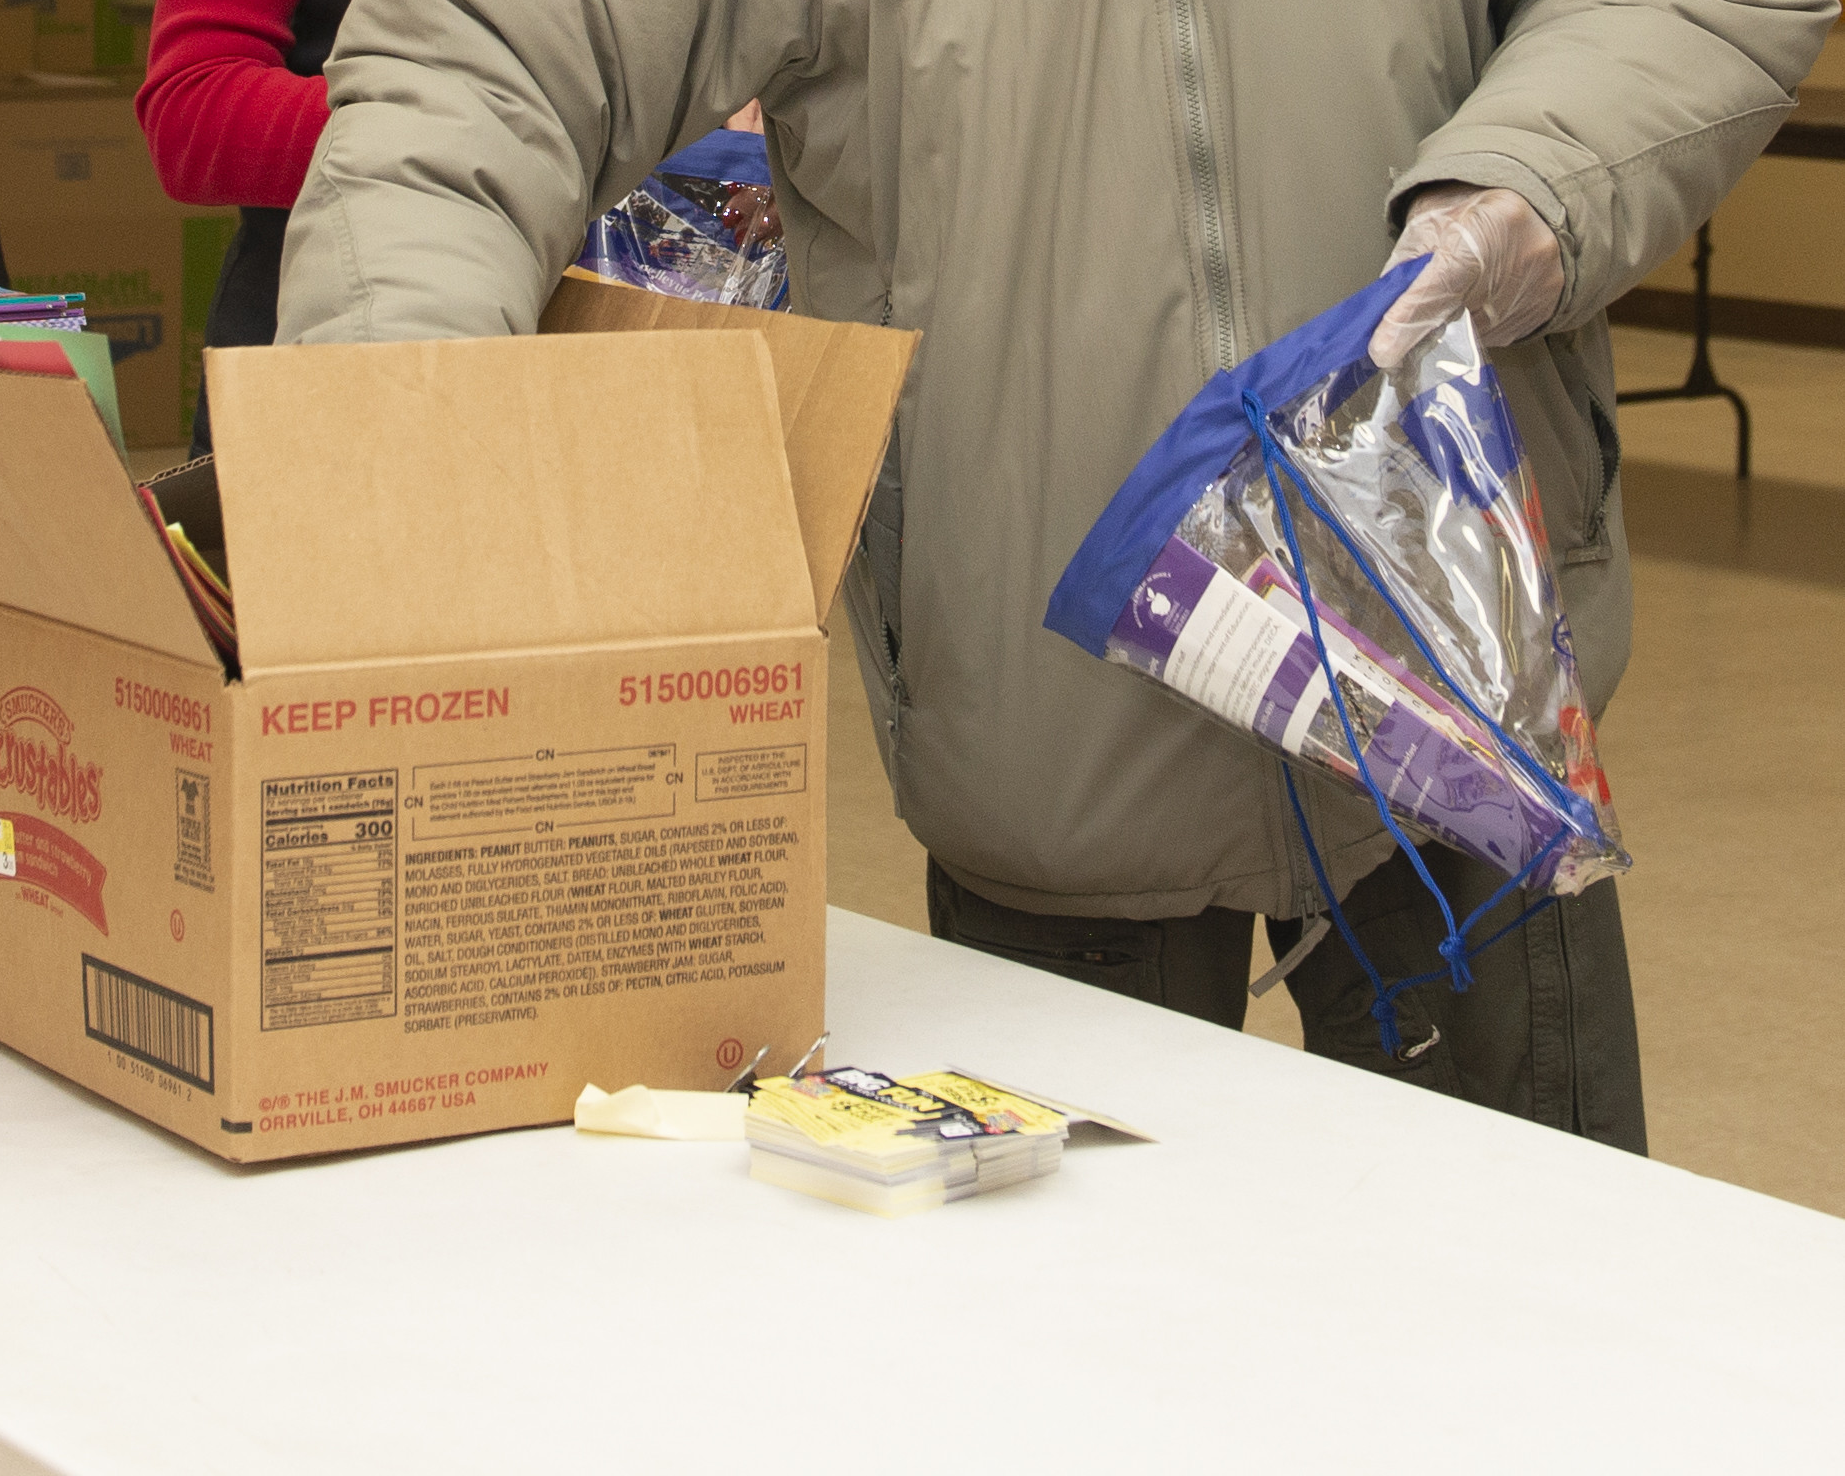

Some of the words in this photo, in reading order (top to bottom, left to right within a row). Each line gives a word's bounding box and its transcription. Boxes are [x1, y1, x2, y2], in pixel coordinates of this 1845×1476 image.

[619, 662, 802, 706] 5150006961
[115, 676, 211, 734] 5150006961
[261, 699, 357, 736] KEEP
[369, 687, 509, 727] FROZEN
[729, 698, 805, 724] WHEAT
[169, 732, 214, 763] WHEAT
[536, 749, 555, 761] CN
[266, 781, 342, 797] Nutrition
[347, 774, 394, 790] Facts
[665, 773, 684, 786] CN
[404, 796, 423, 809] CN
[265, 832, 329, 847] Calories
[354, 820, 392, 839] 300
[480, 843, 522, 858] PEANUT
[660, 824, 709, 840] CONTAINS
[711, 823, 727, 836] 2%
[730, 821, 744, 834] OR
[746, 818, 770, 832] LESS
[535, 821, 553, 833] CN
[405, 884, 438, 899] MONO
[440, 881, 463, 895] AND
[612, 859, 677, 878] UNBLEACHED
[680, 856, 715, 871] WHOLE
[718, 852, 751, 867] WHEAT
[468, 861, 499, 876] FULLY
[501, 853, 583, 873] HYDROGENATED
[586, 848, 641, 864] VEGETABLE
[644, 845, 666, 859] OILS
[669, 839, 724, 858] (RAPESEED
[725, 837, 747, 851] AND
[405, 898, 458, 915] ENRICHED
[461, 891, 528, 910] UNBLEACHED
[531, 887, 565, 902] FLOUR
[567, 883, 606, 900] (WHEAT
[646, 875, 686, 890] MALTED
[688, 871, 725, 886] BARLEY
[446, 911, 495, 928] FERROUS
[546, 902, 588, 917] THIAMIN
[730, 884, 758, 898] FOLIC
[525, 919, 575, 936] CONTAINS
[578, 917, 594, 930] 2%
[596, 915, 611, 928] OR
[613, 912, 638, 926] LESS
[659, 907, 693, 922] WHEAT
[739, 897, 785, 913] SOYBEAN
[405, 967, 447, 983] SODIUM
[450, 960, 503, 978] STEAROYL
[607, 943, 654, 960] ENZYMES
[689, 936, 723, 951] WHEAT
[457, 945, 495, 961] DOUGH
[497, 936, 573, 956] CONDITIONERS
[575, 930, 630, 949] (DISTILLED
[632, 926, 664, 941] MONO
[666, 924, 687, 937] AND
[405, 982, 457, 999] ASCORBIC
[489, 973, 536, 989] CALCIUM
[601, 957, 671, 977] STRAWBERRY
[491, 989, 542, 1006] CONTAINS
[544, 987, 561, 1000] 2%
[563, 985, 578, 998] OR
[580, 982, 605, 996] LESS
[666, 971, 698, 986] CITRIC
[729, 961, 785, 978] POTASSIUM
[405, 1016, 451, 1033] SORBATE
[295, 1089, 330, 1108] THE
[335, 1085, 368, 1103] J.M.
[374, 1073, 459, 1098] SMUCKER
[464, 1062, 549, 1087] COMPANY
[258, 1107, 352, 1133] ORRVILLE,
[358, 1102, 383, 1119] OH
[388, 1096, 436, 1116] 44667
[441, 1091, 476, 1109] USA
